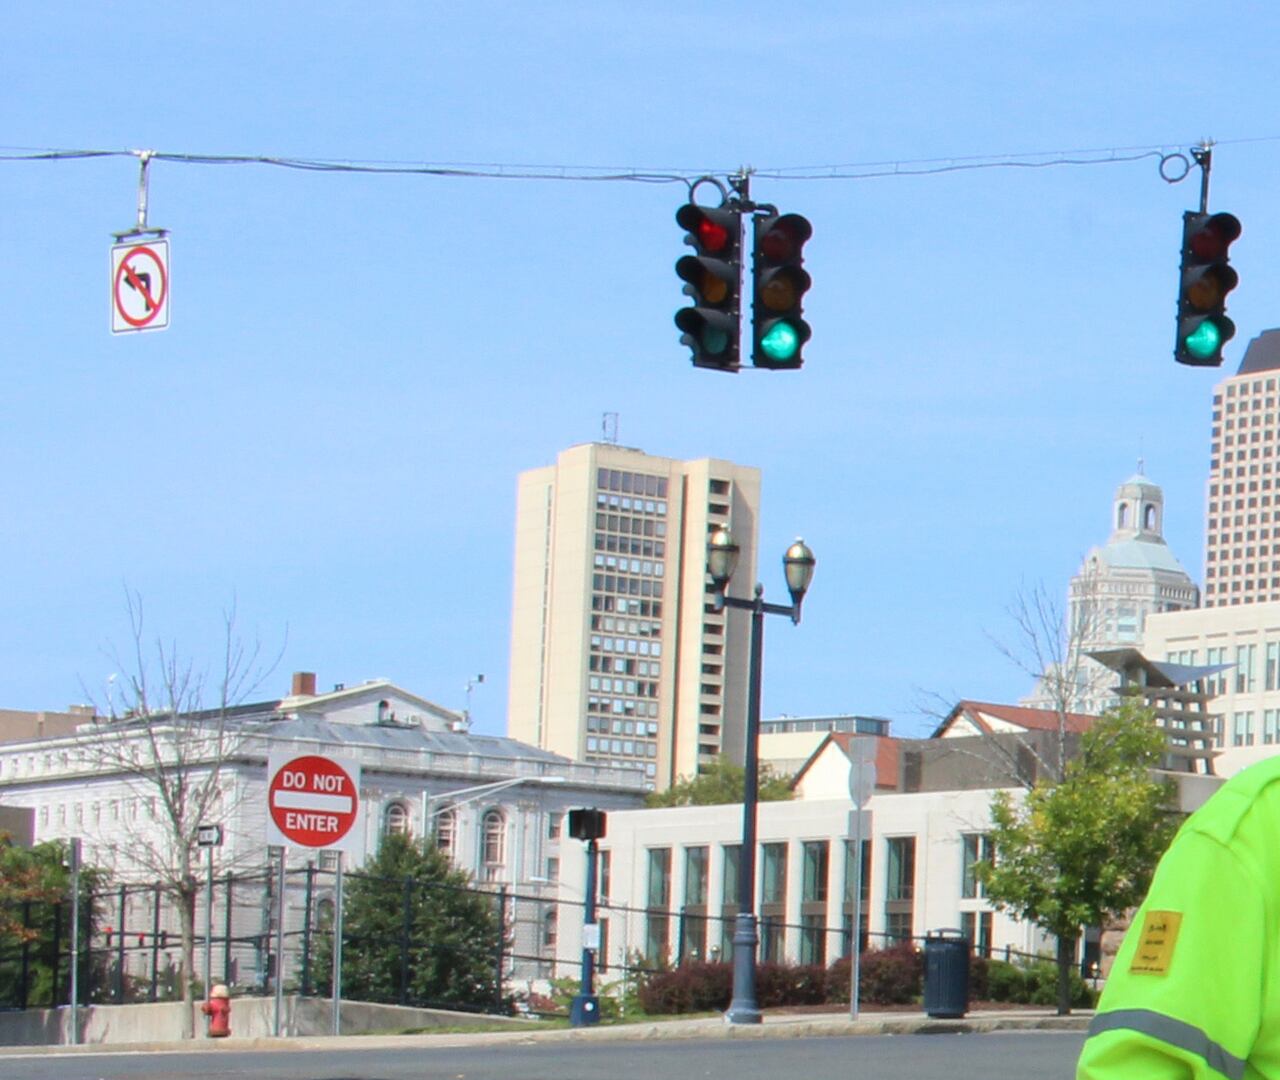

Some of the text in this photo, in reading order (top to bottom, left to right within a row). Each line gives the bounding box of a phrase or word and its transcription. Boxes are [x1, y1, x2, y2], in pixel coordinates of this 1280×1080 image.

[283, 771, 345, 792] DO NOT
[286, 813, 339, 832] ENTER
